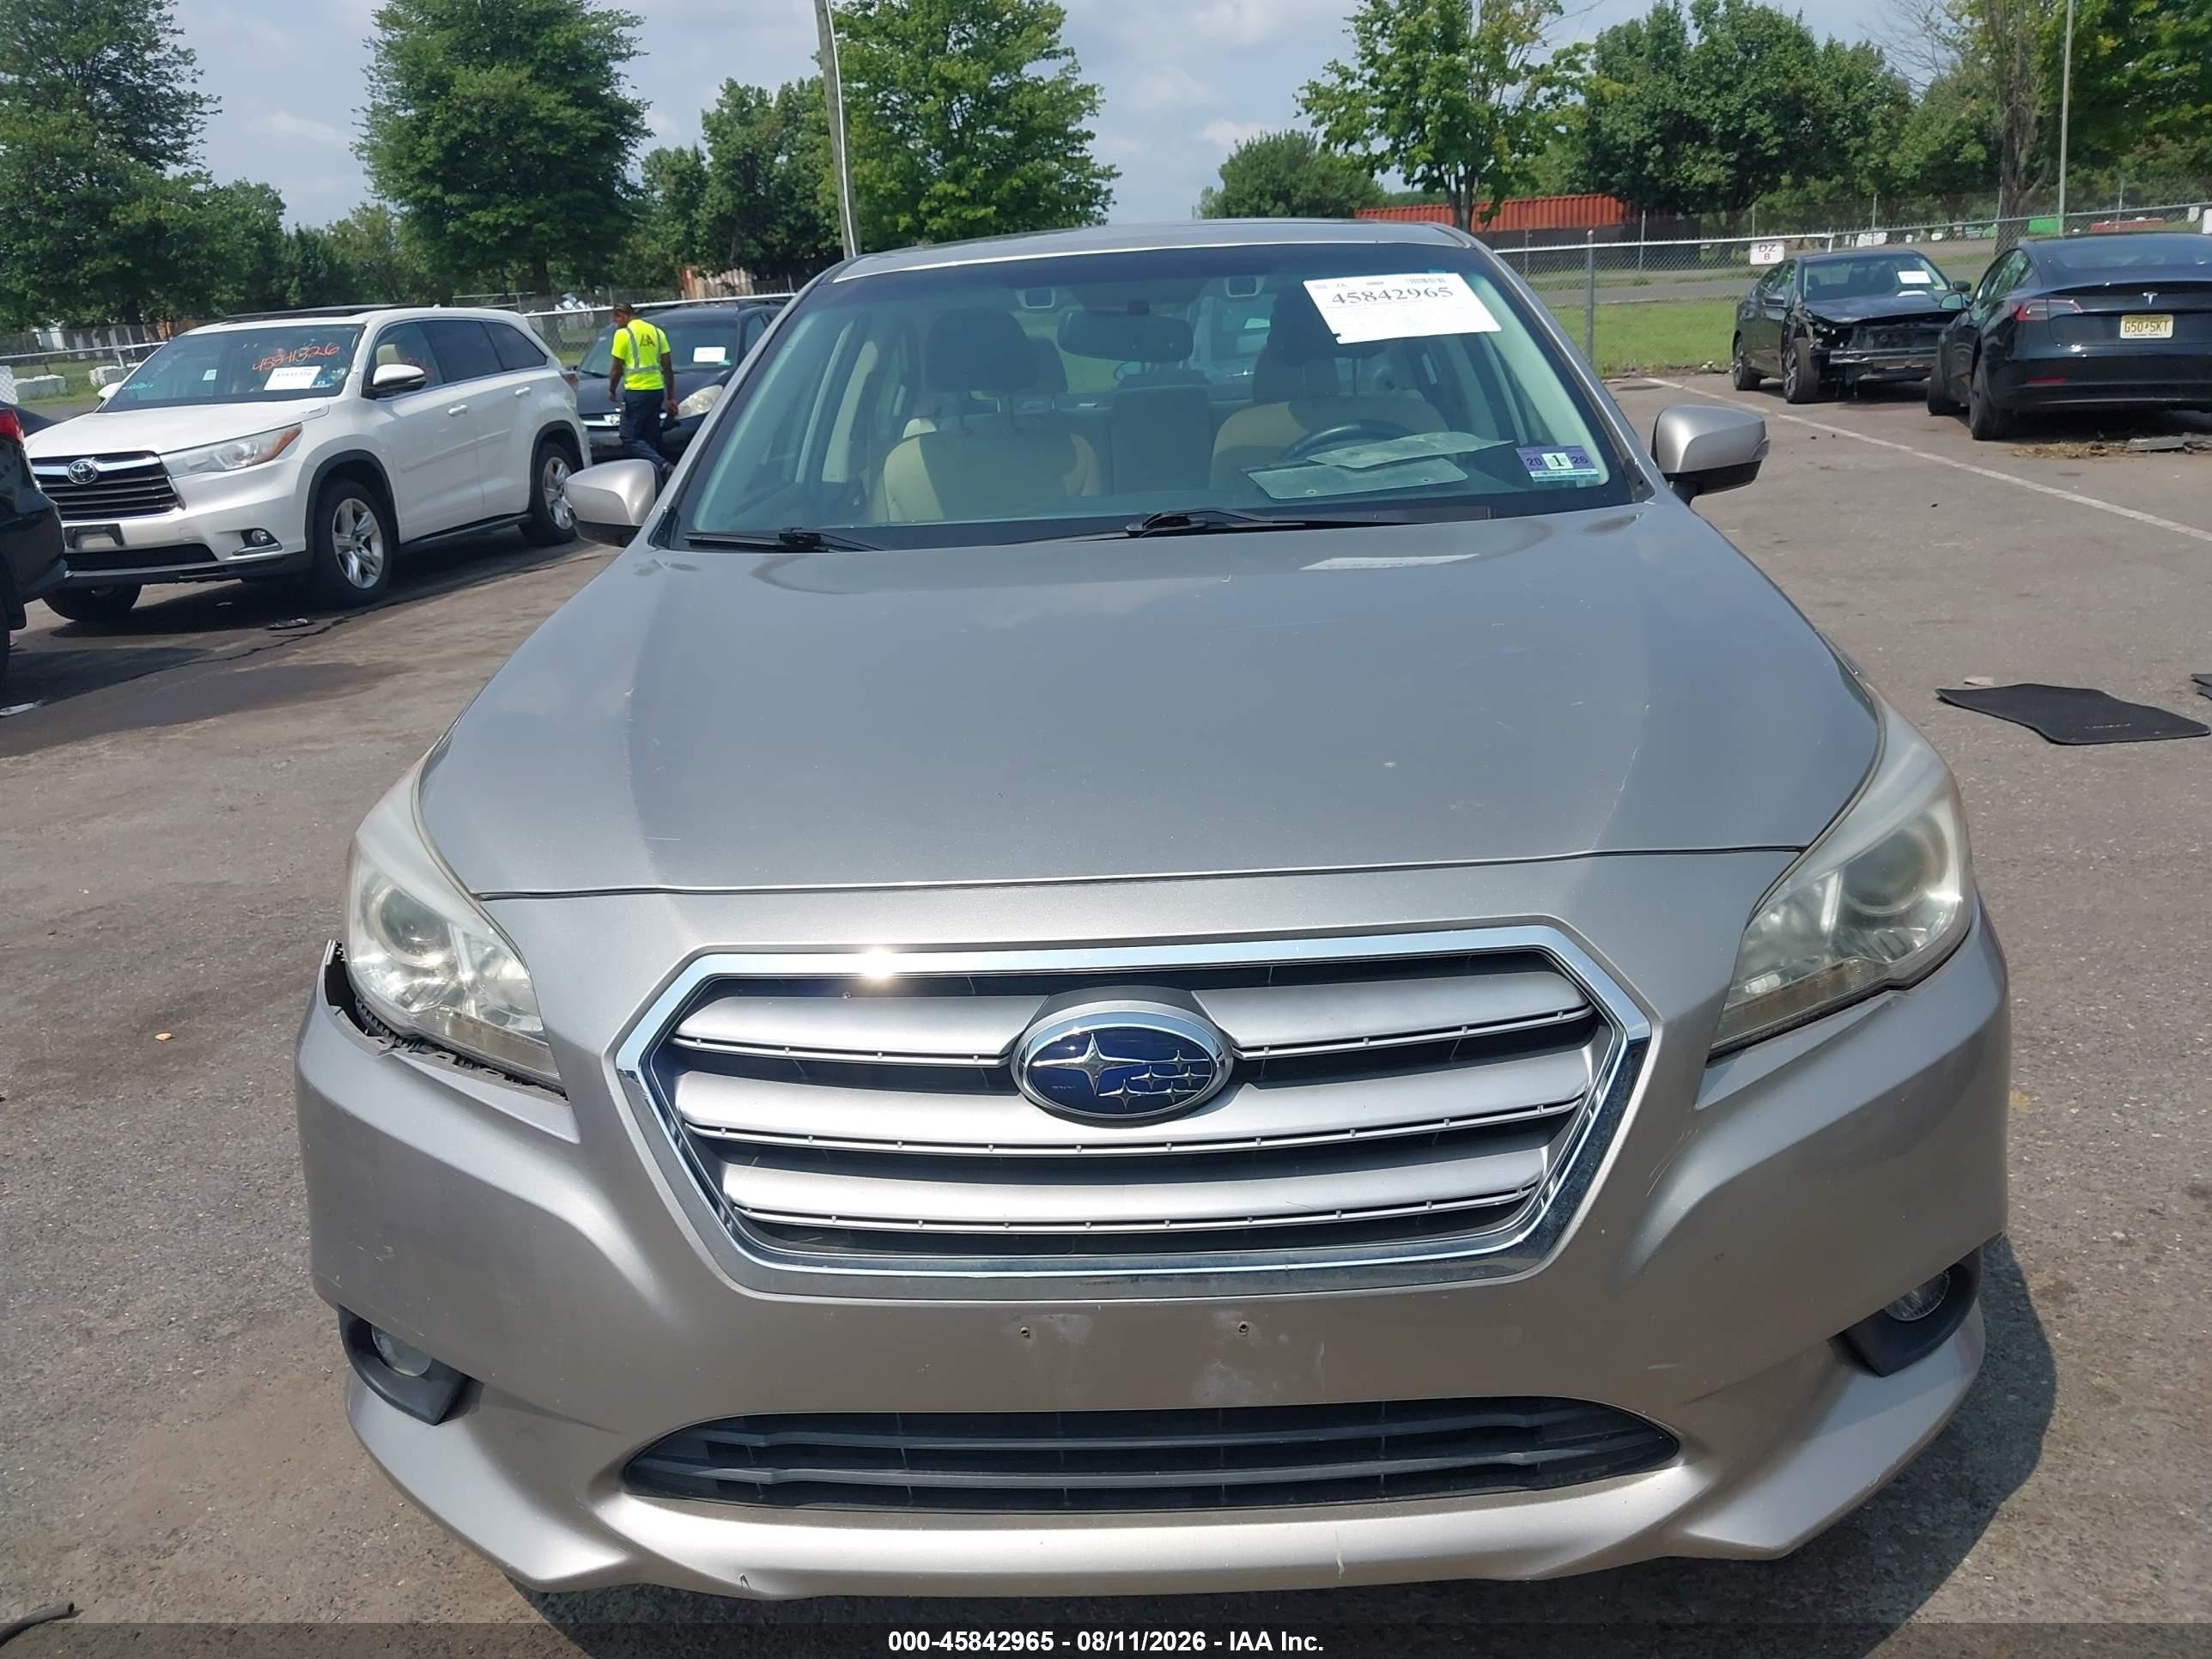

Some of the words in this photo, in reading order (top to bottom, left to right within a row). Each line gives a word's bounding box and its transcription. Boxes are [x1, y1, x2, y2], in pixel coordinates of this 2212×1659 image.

[1759, 244, 1777, 252] DZ
[1332, 286, 1454, 305] 45842965
[1527, 457, 1542, 466] 20
[1552, 454, 1565, 466] 1
